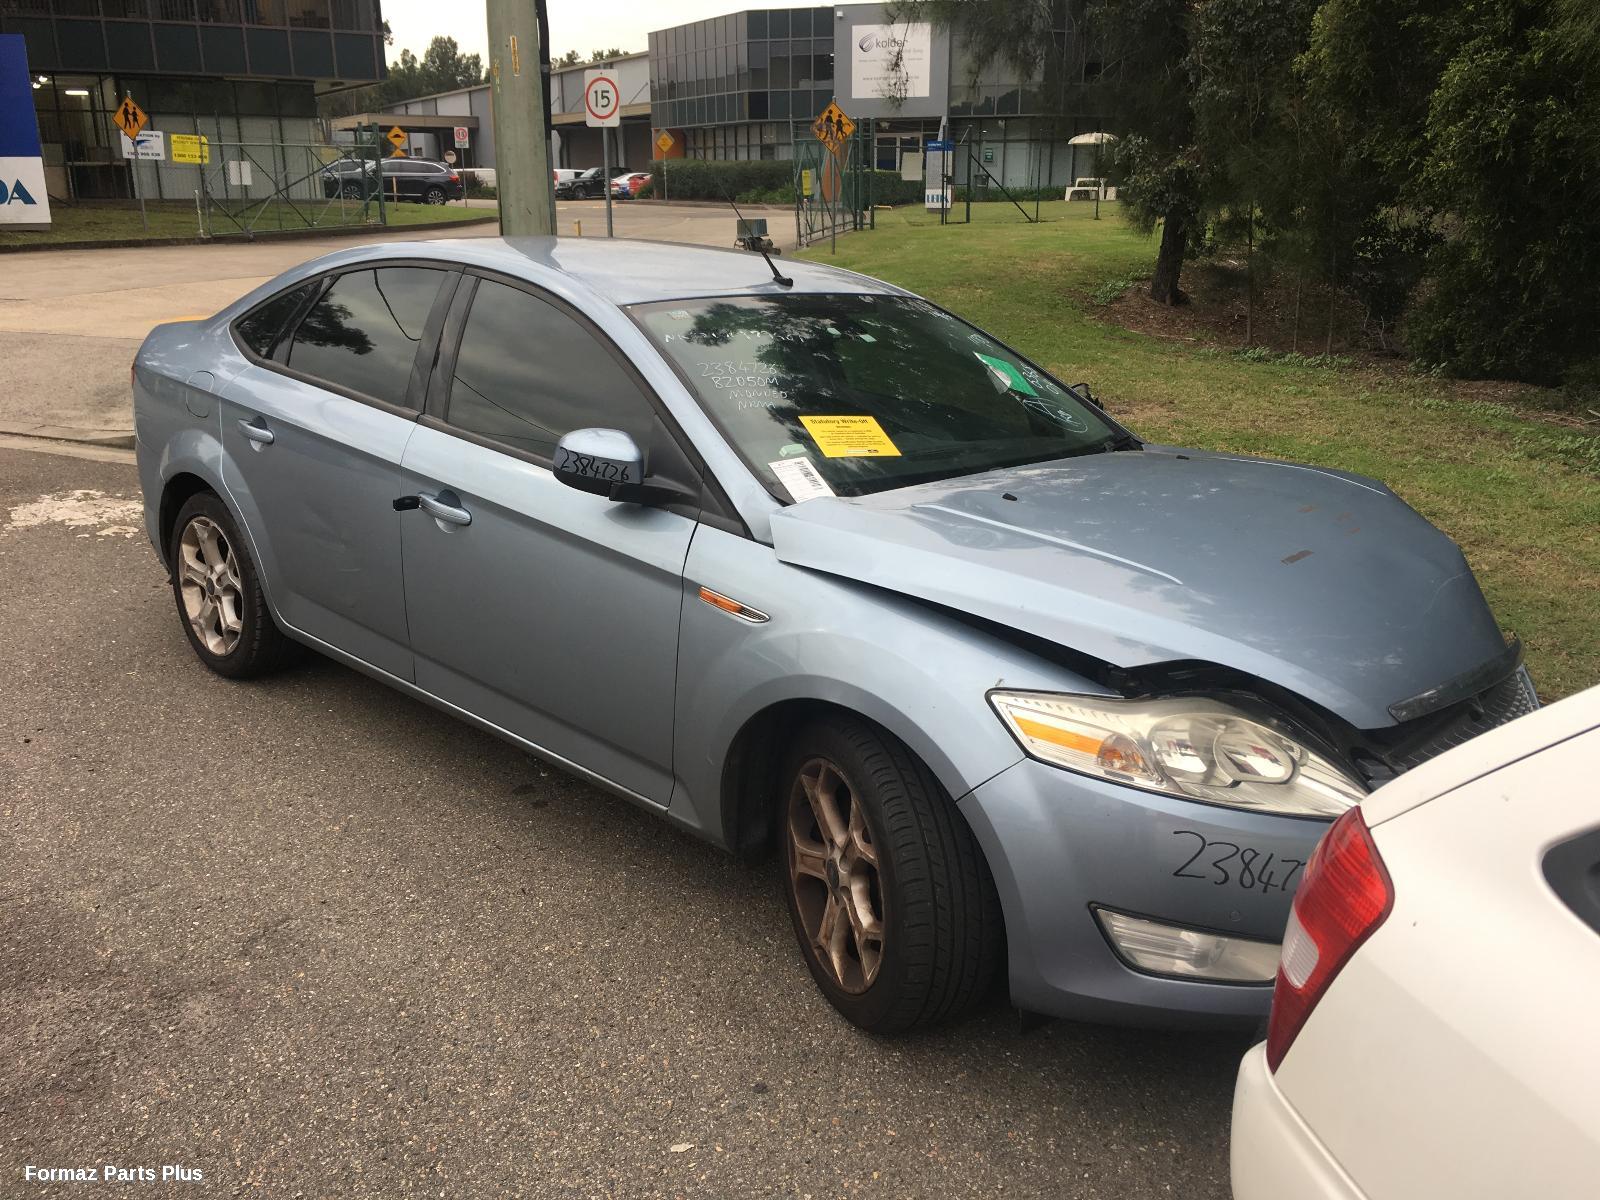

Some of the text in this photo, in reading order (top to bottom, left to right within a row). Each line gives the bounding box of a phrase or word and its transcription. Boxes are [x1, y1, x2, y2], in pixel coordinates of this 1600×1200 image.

[594, 89, 611, 108] 15
[696, 360, 778, 377] 2384726
[559, 446, 630, 484] 2384726
[1172, 830, 1307, 893] 23847
